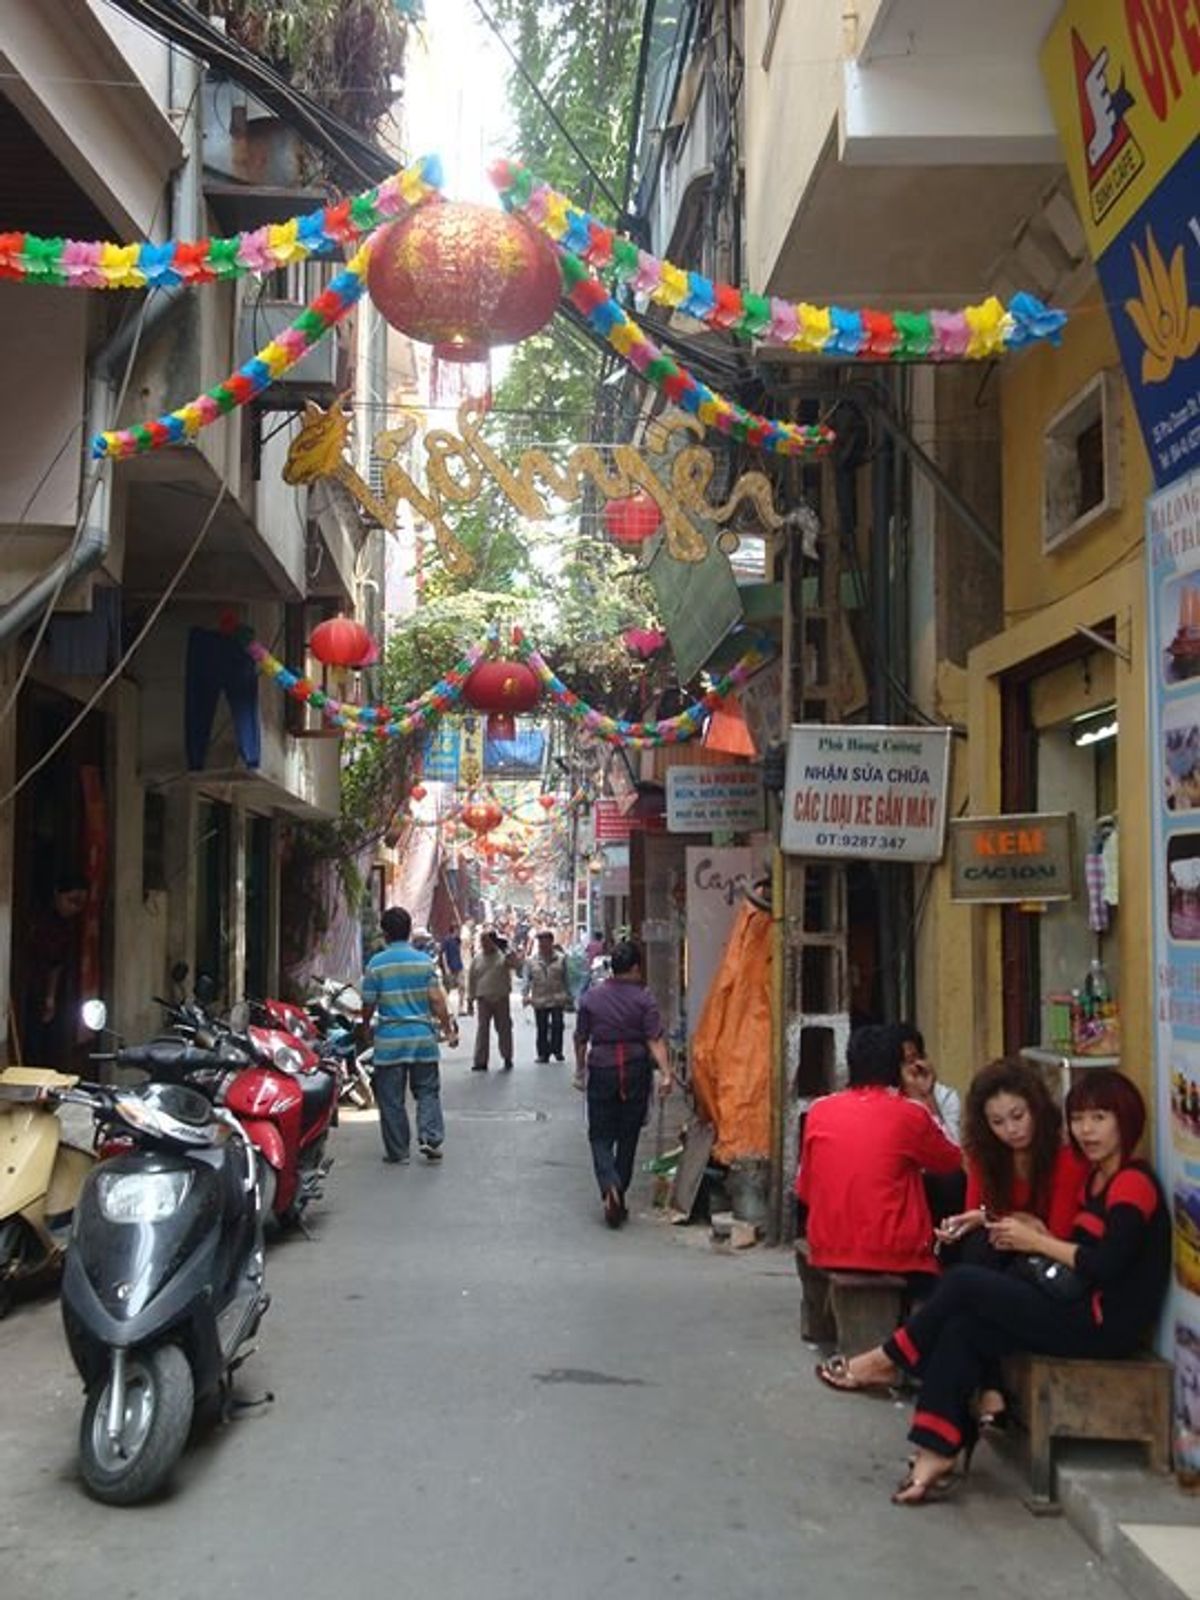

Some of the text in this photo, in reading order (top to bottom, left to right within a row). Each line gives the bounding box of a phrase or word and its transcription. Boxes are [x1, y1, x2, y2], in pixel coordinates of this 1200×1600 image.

[804, 762, 930, 783] NHẬN SỬA CHỮA
[794, 786, 820, 822] CÁC
[823, 792, 852, 829] LOẠI
[855, 795, 872, 825] XE
[906, 789, 936, 828] MÁY
[974, 828, 1046, 856] KEM
